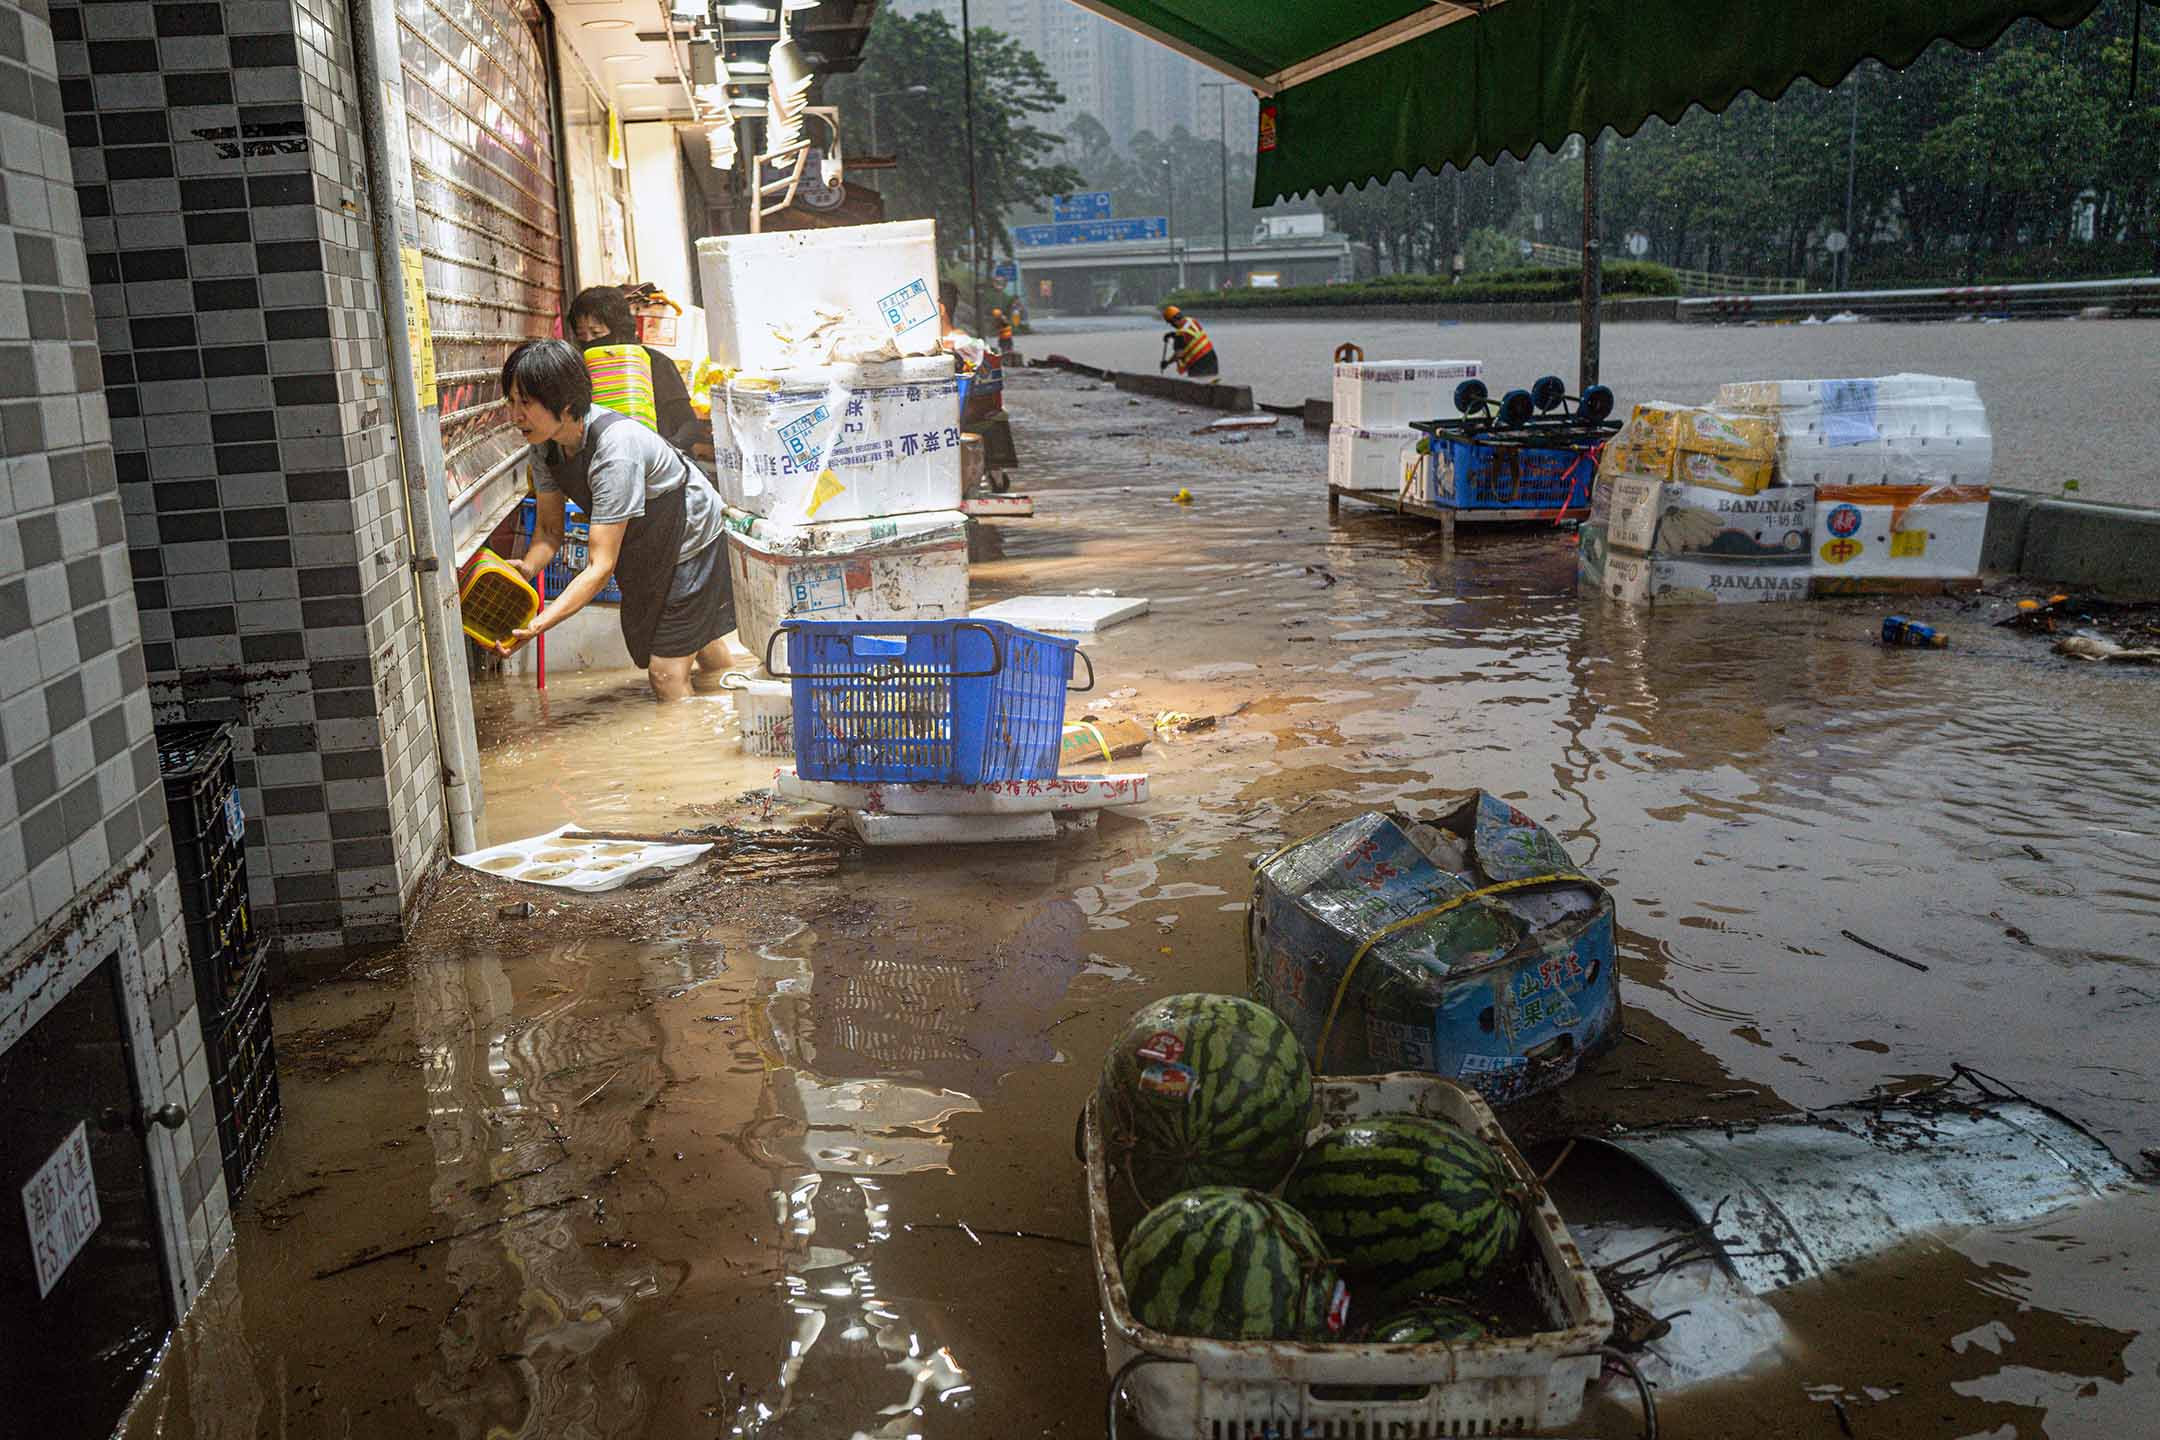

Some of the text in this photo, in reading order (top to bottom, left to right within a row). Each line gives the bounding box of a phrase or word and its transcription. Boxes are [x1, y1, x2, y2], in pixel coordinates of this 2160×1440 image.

[887, 309, 901, 324] B
[790, 438, 803, 454] B
[1711, 575, 1804, 591] BANANAS
[795, 585, 808, 601] B
